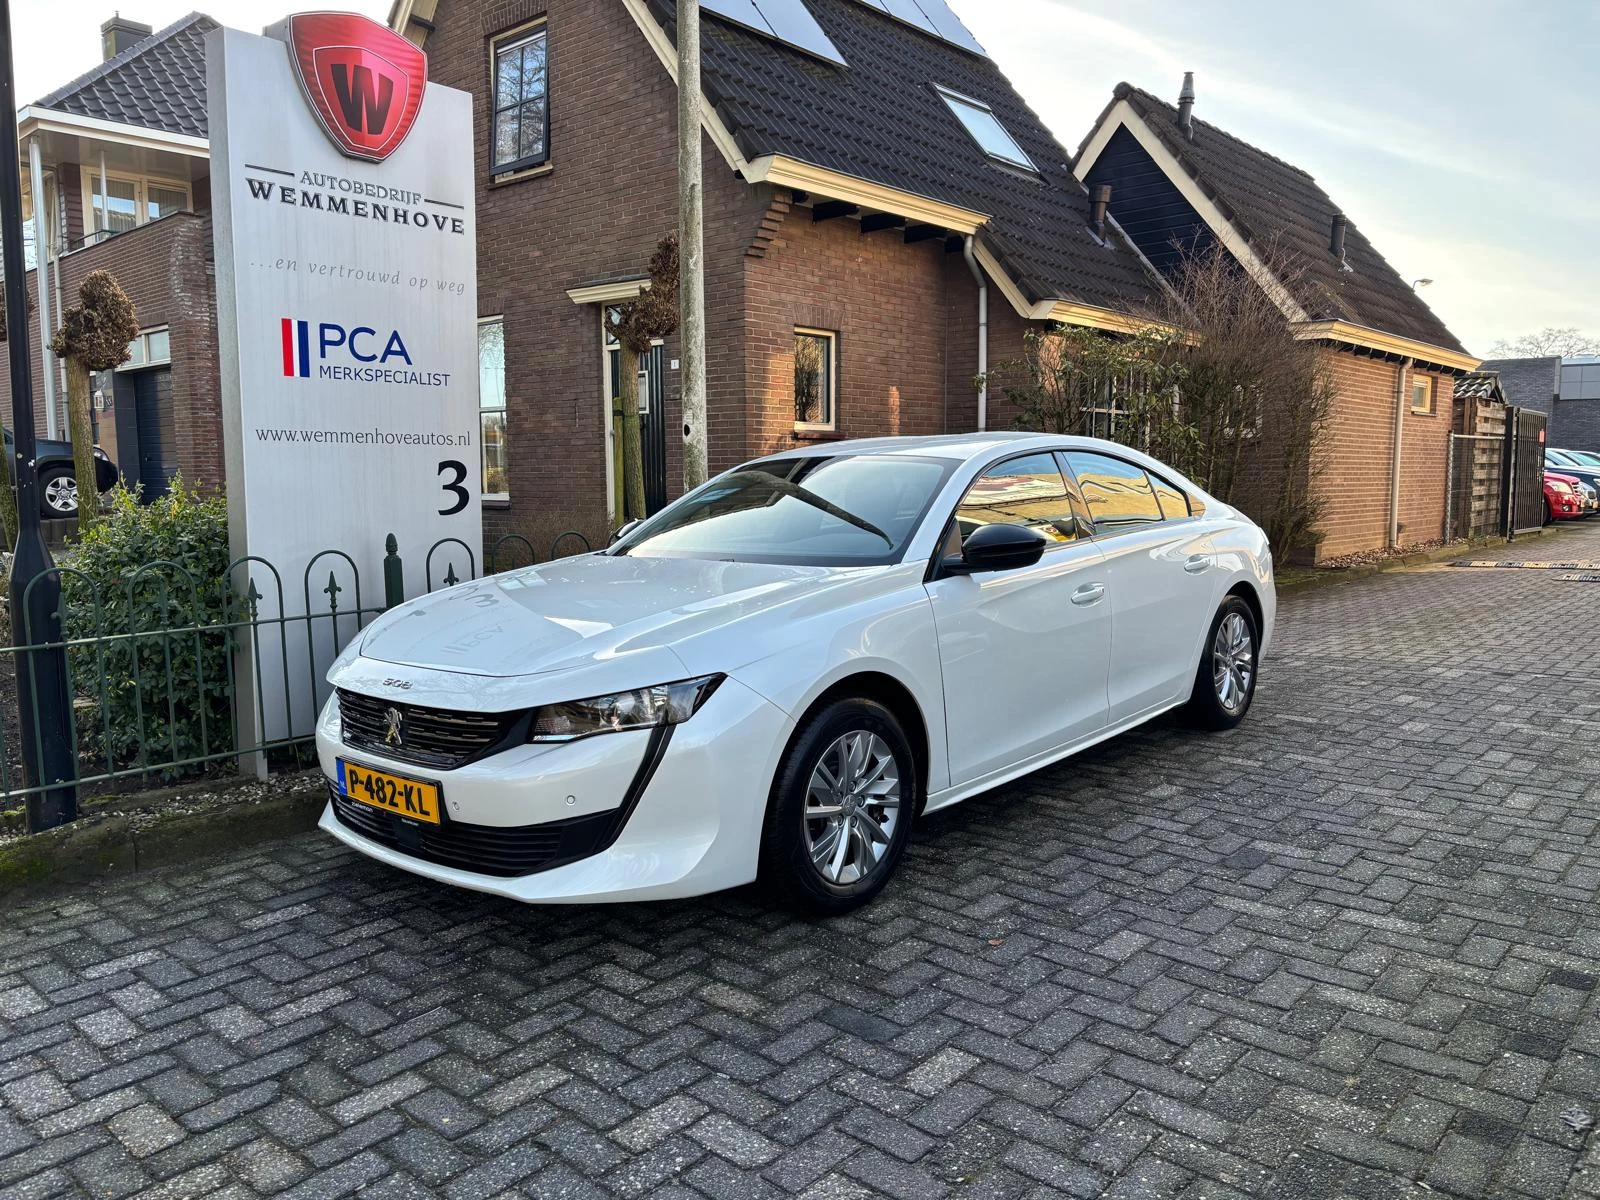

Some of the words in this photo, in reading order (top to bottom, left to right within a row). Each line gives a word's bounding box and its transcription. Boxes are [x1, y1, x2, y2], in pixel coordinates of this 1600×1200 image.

[330, 63, 394, 136] W
[245, 178, 465, 235] WEMMENHOVE
[300, 170, 422, 205] AUTOBEDRIJF
[308, 262, 401, 285] vertrouwd
[409, 276, 428, 291] op
[436, 279, 466, 296] weg
[319, 322, 413, 366] PCA
[319, 365, 451, 387] MERKSPECIALIST
[255, 427, 471, 447] www.wemmenhoveautos.nl
[437, 459, 470, 516] 3
[382, 678, 413, 690] 508
[349, 768, 430, 817] P-482-KL
